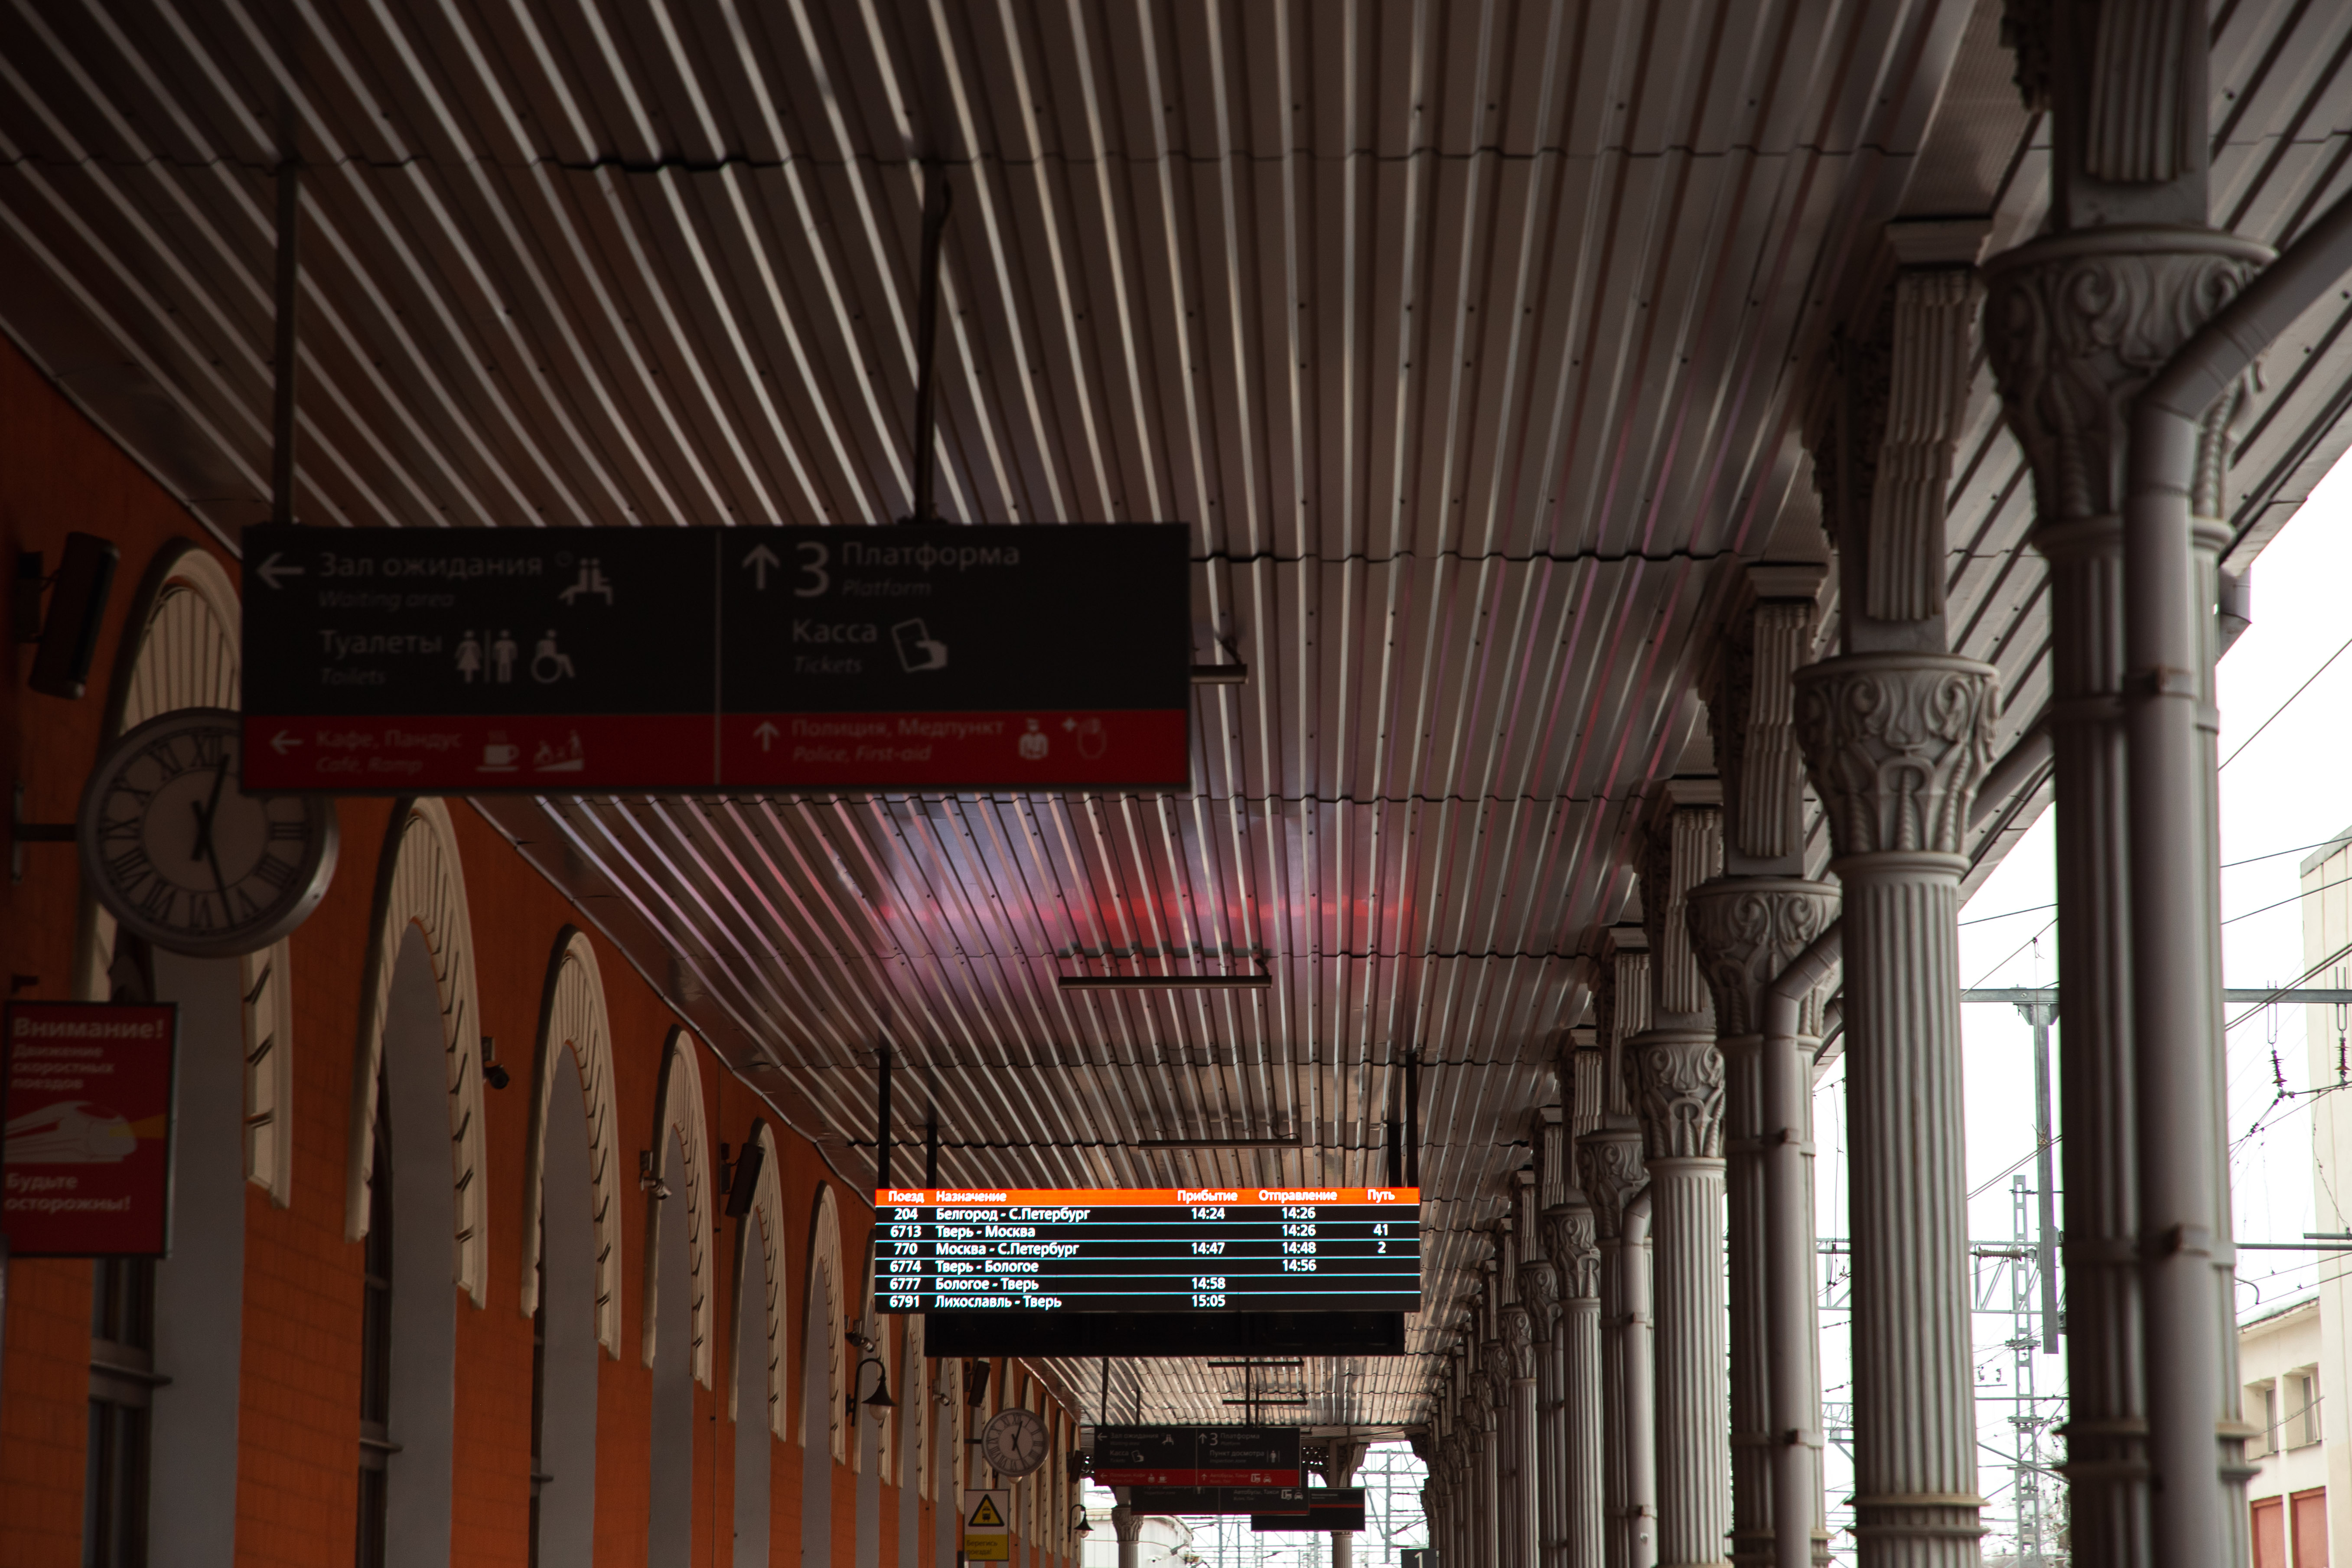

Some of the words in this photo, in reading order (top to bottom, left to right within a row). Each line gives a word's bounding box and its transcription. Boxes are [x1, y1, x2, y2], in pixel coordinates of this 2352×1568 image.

[319, 552, 374, 577] Зал
[382, 555, 544, 580] ожидания
[842, 541, 1020, 572] Платформа
[793, 541, 830, 598] 3
[841, 579, 932, 597] Platform
[318, 590, 401, 611] Waiting
[405, 593, 455, 607] area
[792, 619, 878, 644] Касса
[319, 629, 443, 658] Туалеты
[793, 655, 863, 674] Tickets
[319, 667, 386, 686] Toilets
[792, 718, 892, 739] Полиция,
[897, 718, 1005, 740] Медпункт
[315, 729, 380, 752] Кафе,
[384, 729, 462, 752] Пандус
[793, 745, 850, 763] Police,
[855, 744, 932, 762] First-aid
[367, 756, 424, 776] Ramp
[13, 1017, 164, 1039] Внимание!
[12, 1043, 104, 1059] Движение
[11, 1062, 115, 1076] скоростных
[6, 1172, 78, 1193] Будьте
[4, 1195, 131, 1214] осторожны!
[889, 1190, 925, 1203] Поезд
[936, 1190, 1007, 1202] Назначение
[1176, 1190, 1238, 1203] Прибытие
[1258, 1190, 1338, 1203] Отправление
[1367, 1189, 1395, 1203] Путь
[894, 1208, 918, 1220] 204
[936, 1208, 998, 1222] Белгород
[1009, 1207, 1091, 1222] С.Петербург
[1191, 1207, 1225, 1219] 14:24
[1282, 1206, 1316, 1219] 14:26
[890, 1225, 922, 1238] 6713
[935, 1225, 974, 1240] Тверь
[985, 1225, 1036, 1238] Москва
[1282, 1224, 1316, 1237] 14:26
[1373, 1224, 1388, 1236] 41
[894, 1242, 918, 1255] 770
[936, 1242, 986, 1255] Москва
[997, 1242, 1079, 1258] С.Петербург
[1191, 1242, 1225, 1255] 14:47
[1282, 1242, 1316, 1254] 14:48
[1377, 1241, 1386, 1254] 2
[889, 1260, 922, 1273] 6774
[935, 1260, 974, 1275] Тверь
[985, 1260, 1039, 1273] Бологое
[1282, 1259, 1317, 1271] 14:56
[889, 1278, 921, 1290] 6777
[935, 1278, 990, 1290] Бологое
[1000, 1278, 1039, 1293] Тверь
[1192, 1277, 1225, 1290] 14:58
[889, 1295, 919, 1308] 6791
[934, 1295, 1012, 1308] Лихославль
[1023, 1295, 1062, 1311] Тверь
[1192, 1294, 1225, 1307] 15:05
[1209, 1432, 1218, 1446] 3
